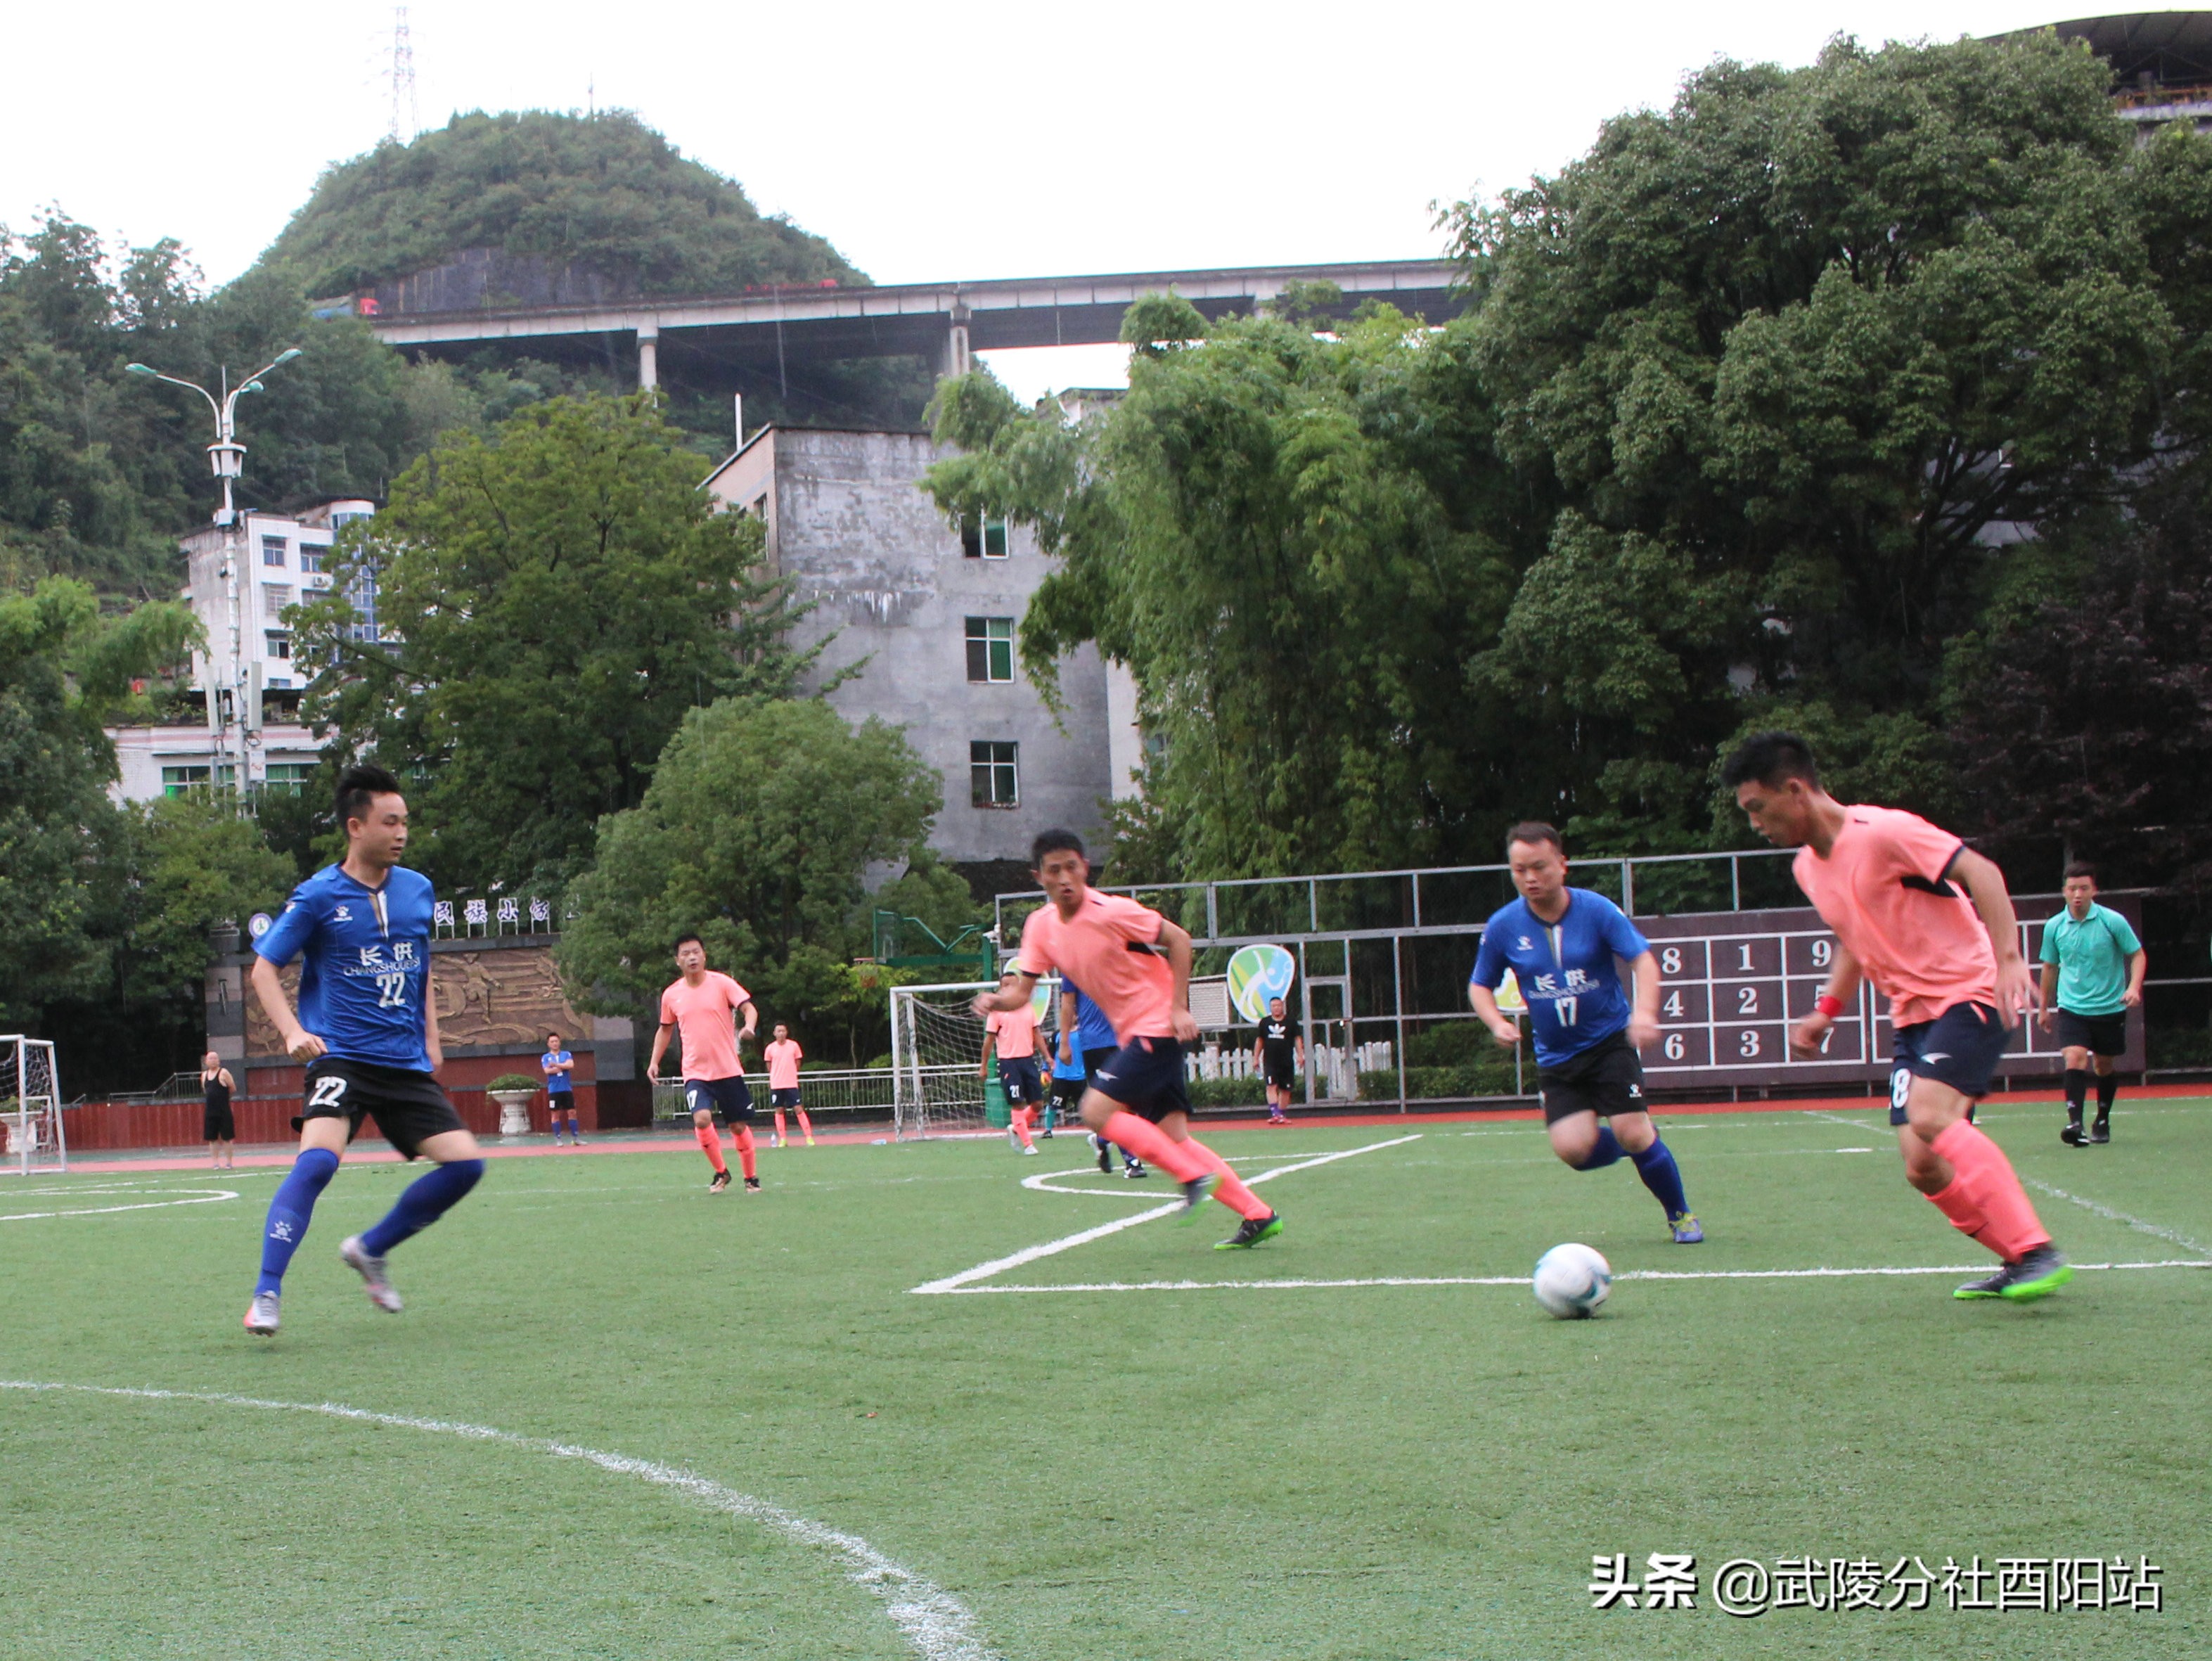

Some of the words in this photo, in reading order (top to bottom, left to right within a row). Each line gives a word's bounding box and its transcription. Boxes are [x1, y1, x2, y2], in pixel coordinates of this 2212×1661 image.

[1662, 947, 1682, 974] 8
[1737, 944, 1755, 970] 1
[1811, 939, 1832, 967] 9
[376, 972, 406, 1008] 22
[1664, 990, 1685, 1017] 4
[1738, 987, 1758, 1014] 2
[1555, 996, 1577, 1027] 17
[1664, 1033, 1685, 1060] 6
[1740, 1030, 1760, 1057] 3
[309, 1076, 347, 1108] 22
[1009, 1084, 1020, 1098] 21
[1889, 1068, 1911, 1109] 8
